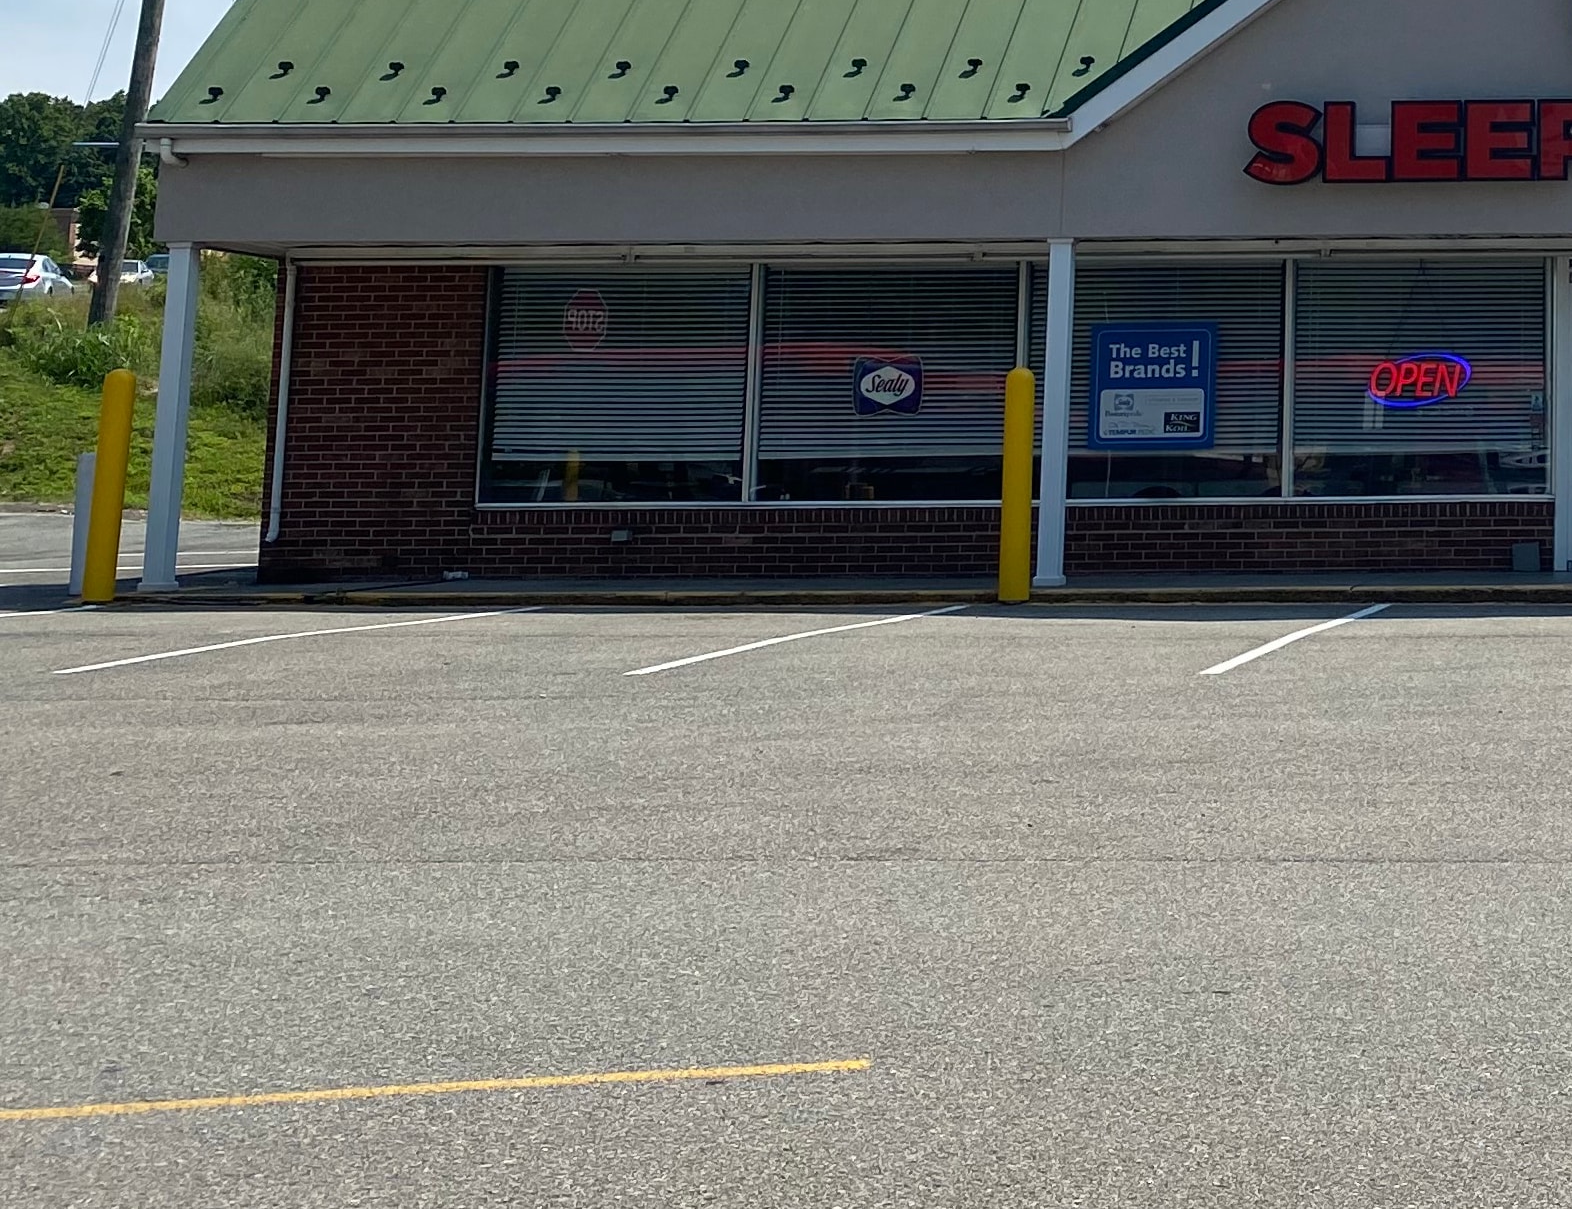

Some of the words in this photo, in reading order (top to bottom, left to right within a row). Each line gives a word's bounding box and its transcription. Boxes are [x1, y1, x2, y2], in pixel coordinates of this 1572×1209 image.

[1109, 343, 1142, 358] The
[1147, 343, 1187, 358] Best
[865, 373, 910, 397] Sealy
[1370, 361, 1462, 397] OPEN
